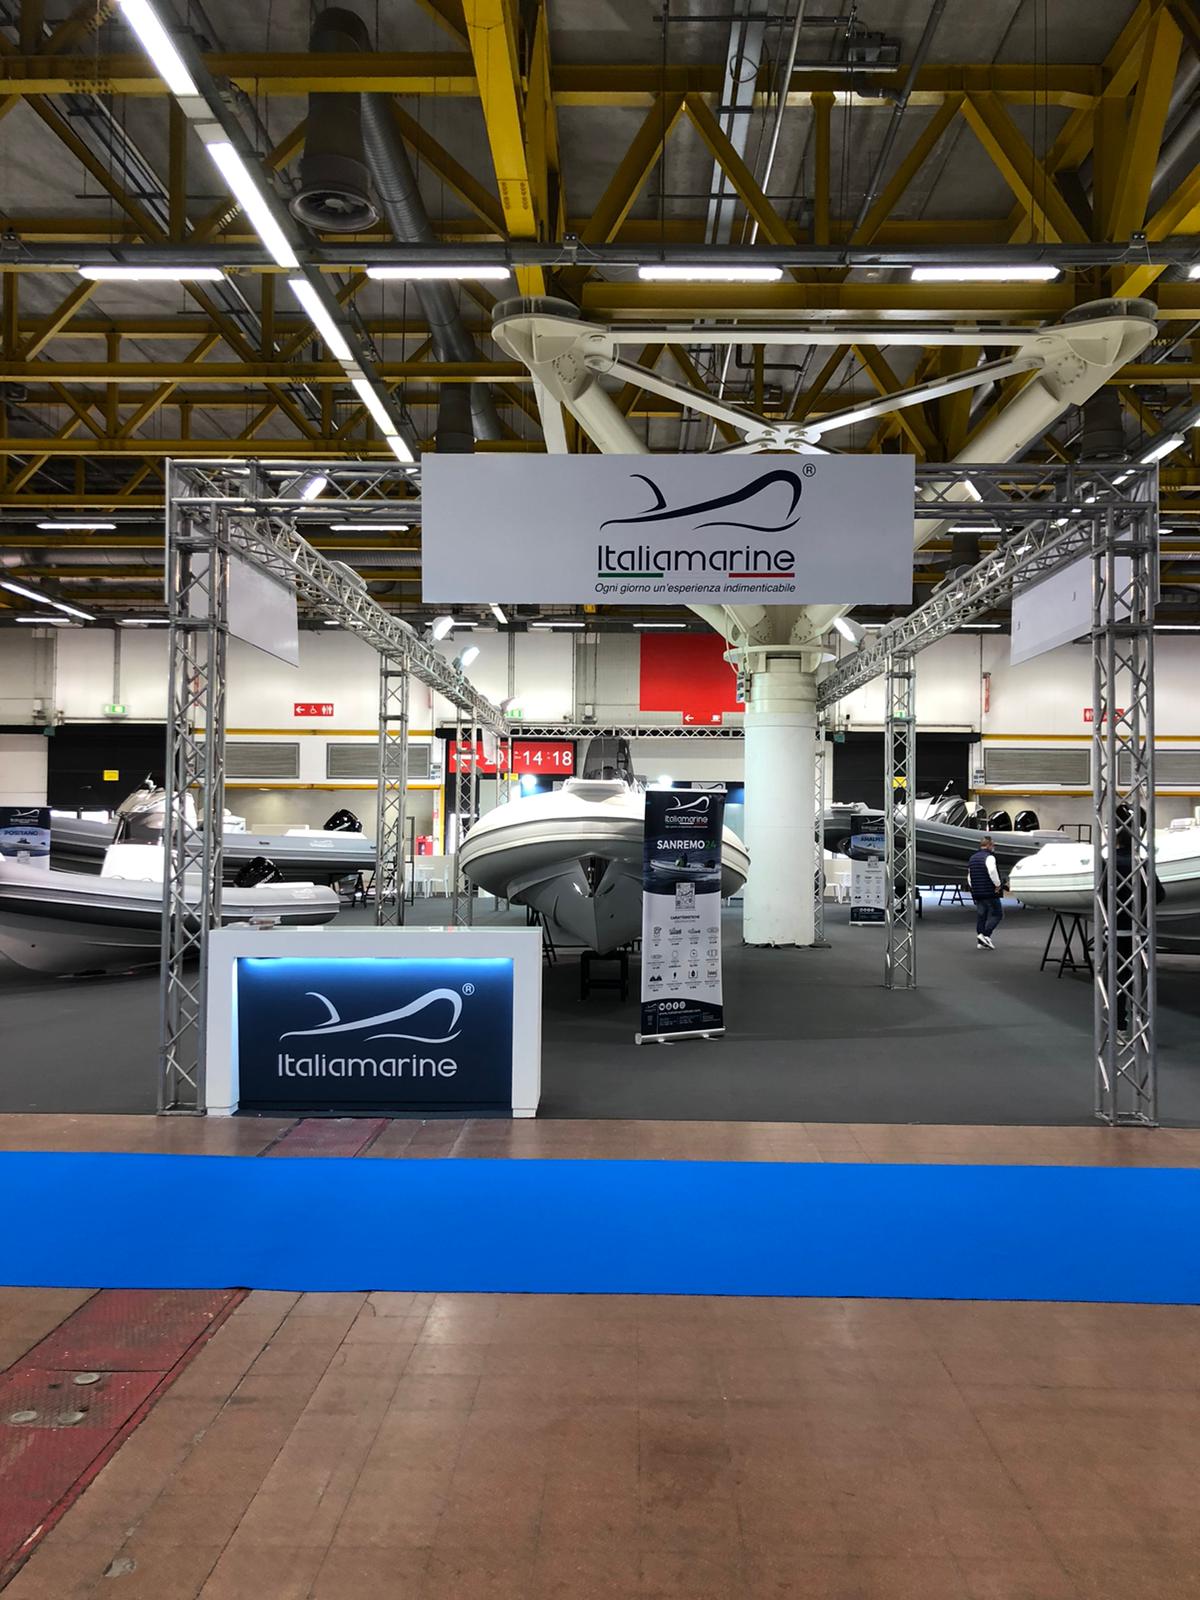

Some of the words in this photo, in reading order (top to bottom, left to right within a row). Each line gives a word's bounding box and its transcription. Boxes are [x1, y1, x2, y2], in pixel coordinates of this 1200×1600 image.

[598, 545, 795, 571] Italiamarine
[595, 582, 619, 594] Ogni
[620, 582, 650, 594] giorno
[653, 582, 721, 594] un'esperienza
[723, 582, 796, 593] indimenticabile
[523, 750, 543, 766] 14
[553, 750, 572, 766] 18
[278, 1054, 458, 1078] Italiamarine
